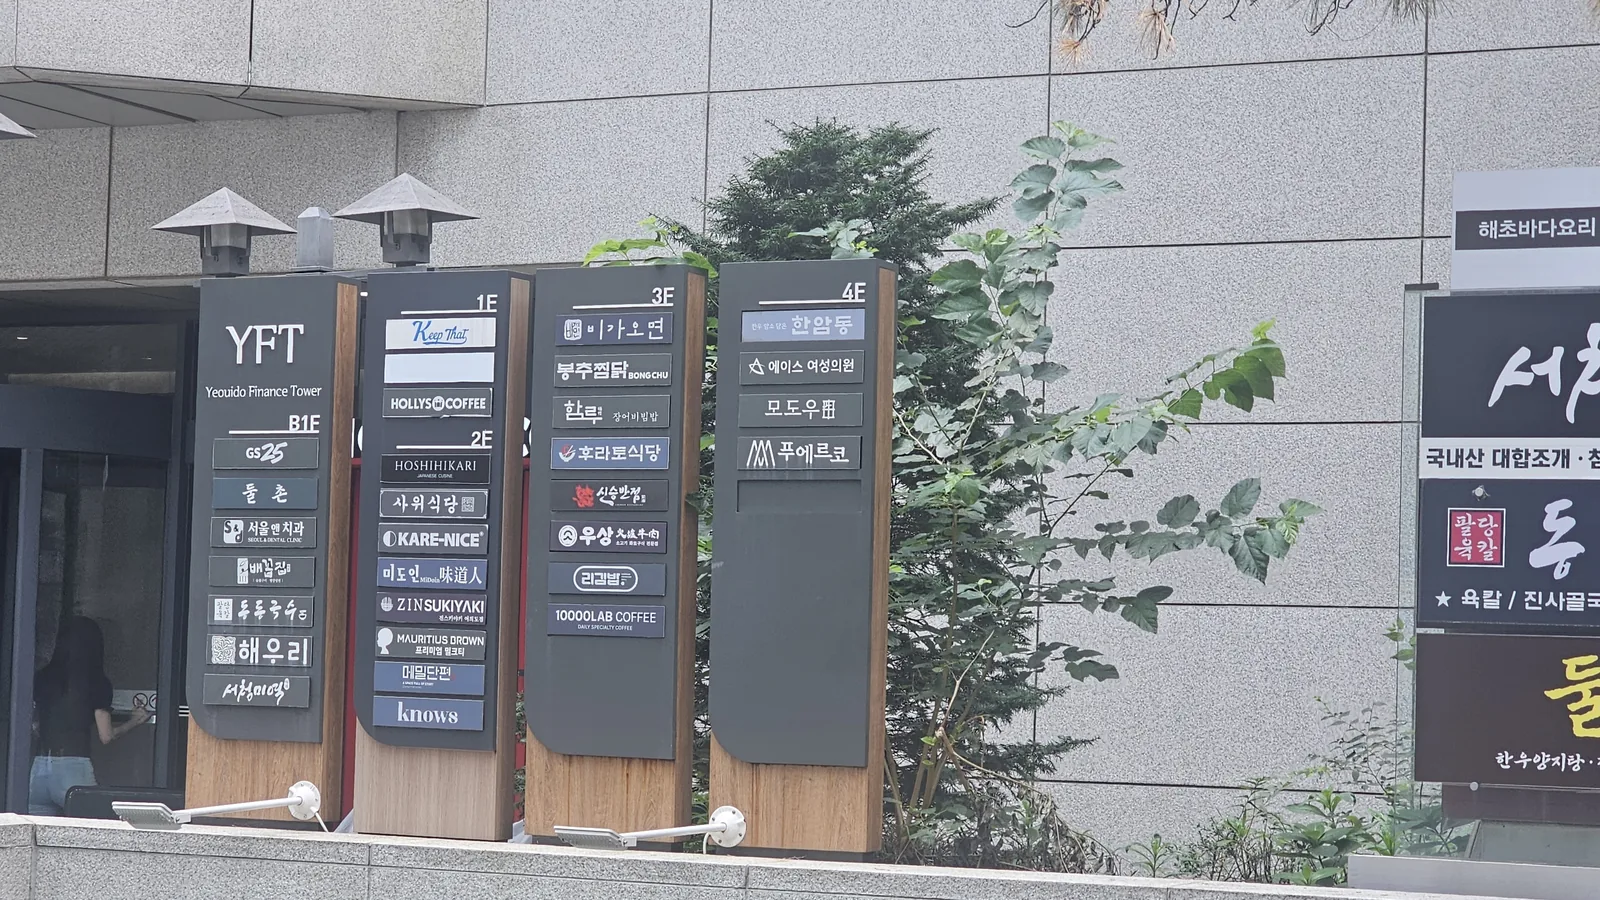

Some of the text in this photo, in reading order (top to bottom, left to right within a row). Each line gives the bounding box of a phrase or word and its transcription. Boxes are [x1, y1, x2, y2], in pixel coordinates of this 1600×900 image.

[1478, 217, 1596, 240] 해초바다요리
[652, 287, 674, 304] 3F
[842, 282, 866, 300] 4F
[477, 294, 498, 312] 1F
[412, 320, 469, 342] Keep That
[791, 315, 853, 335] 한암동
[225, 324, 304, 364] YFT
[557, 361, 629, 380] 봉추찜닭
[768, 358, 854, 374] 에이스 여성의원
[205, 384, 322, 398] Yeouido Finance Tower
[390, 397, 486, 410] HOLLYS COFFEE
[764, 399, 820, 420] 모도우
[289, 415, 320, 432] B1F
[612, 411, 658, 422] 장어비빔밥
[471, 430, 493, 447] 2F
[246, 442, 288, 464] GS25
[578, 444, 661, 462] 후라토식당
[777, 441, 849, 464] 푸에르코
[1426, 448, 1484, 470] 국내산
[1492, 448, 1570, 470] 대합조개
[395, 460, 476, 471] HOSHIHIKARI
[393, 494, 458, 514] 사위식당
[1454, 512, 1498, 537] 팔당
[579, 526, 614, 546] 우상
[383, 563, 419, 583] 미도인
[440, 566, 482, 584] 味道人
[581, 572, 620, 586] 리김밥
[1461, 588, 1502, 610] 육칼
[555, 609, 656, 623] 10000LAB COFFEE
[397, 634, 484, 646] MAURITIUS BROWN
[239, 637, 308, 665] 해우리
[415, 646, 442, 656] 프리미엄
[402, 665, 451, 681] 메밀단편
[397, 701, 459, 724] knows
